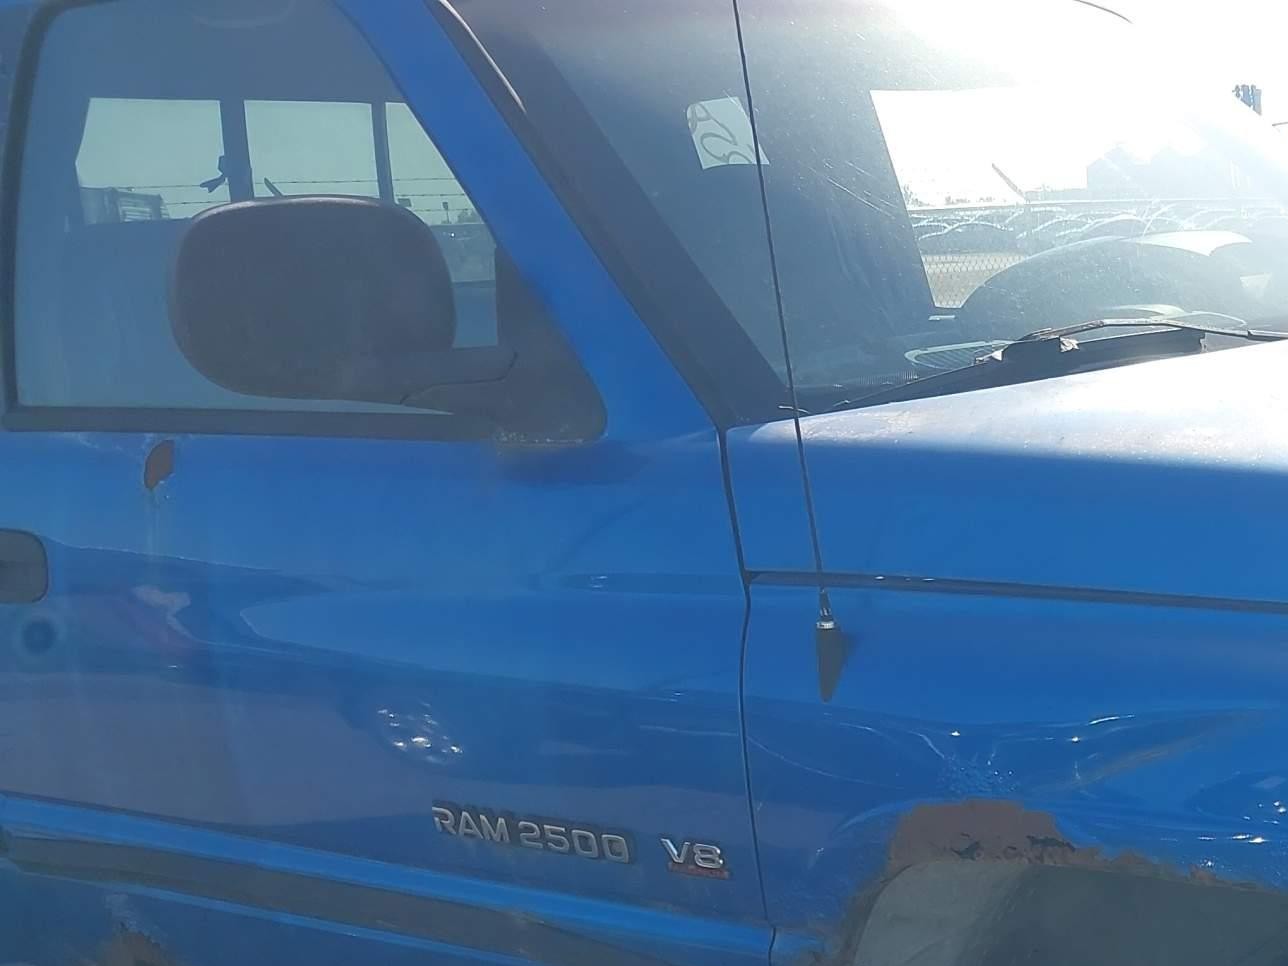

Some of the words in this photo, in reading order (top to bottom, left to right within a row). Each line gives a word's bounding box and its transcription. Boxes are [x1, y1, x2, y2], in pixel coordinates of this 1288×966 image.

[431, 806, 510, 844] RAM
[518, 820, 631, 864] 2500
[660, 837, 724, 869] V8
